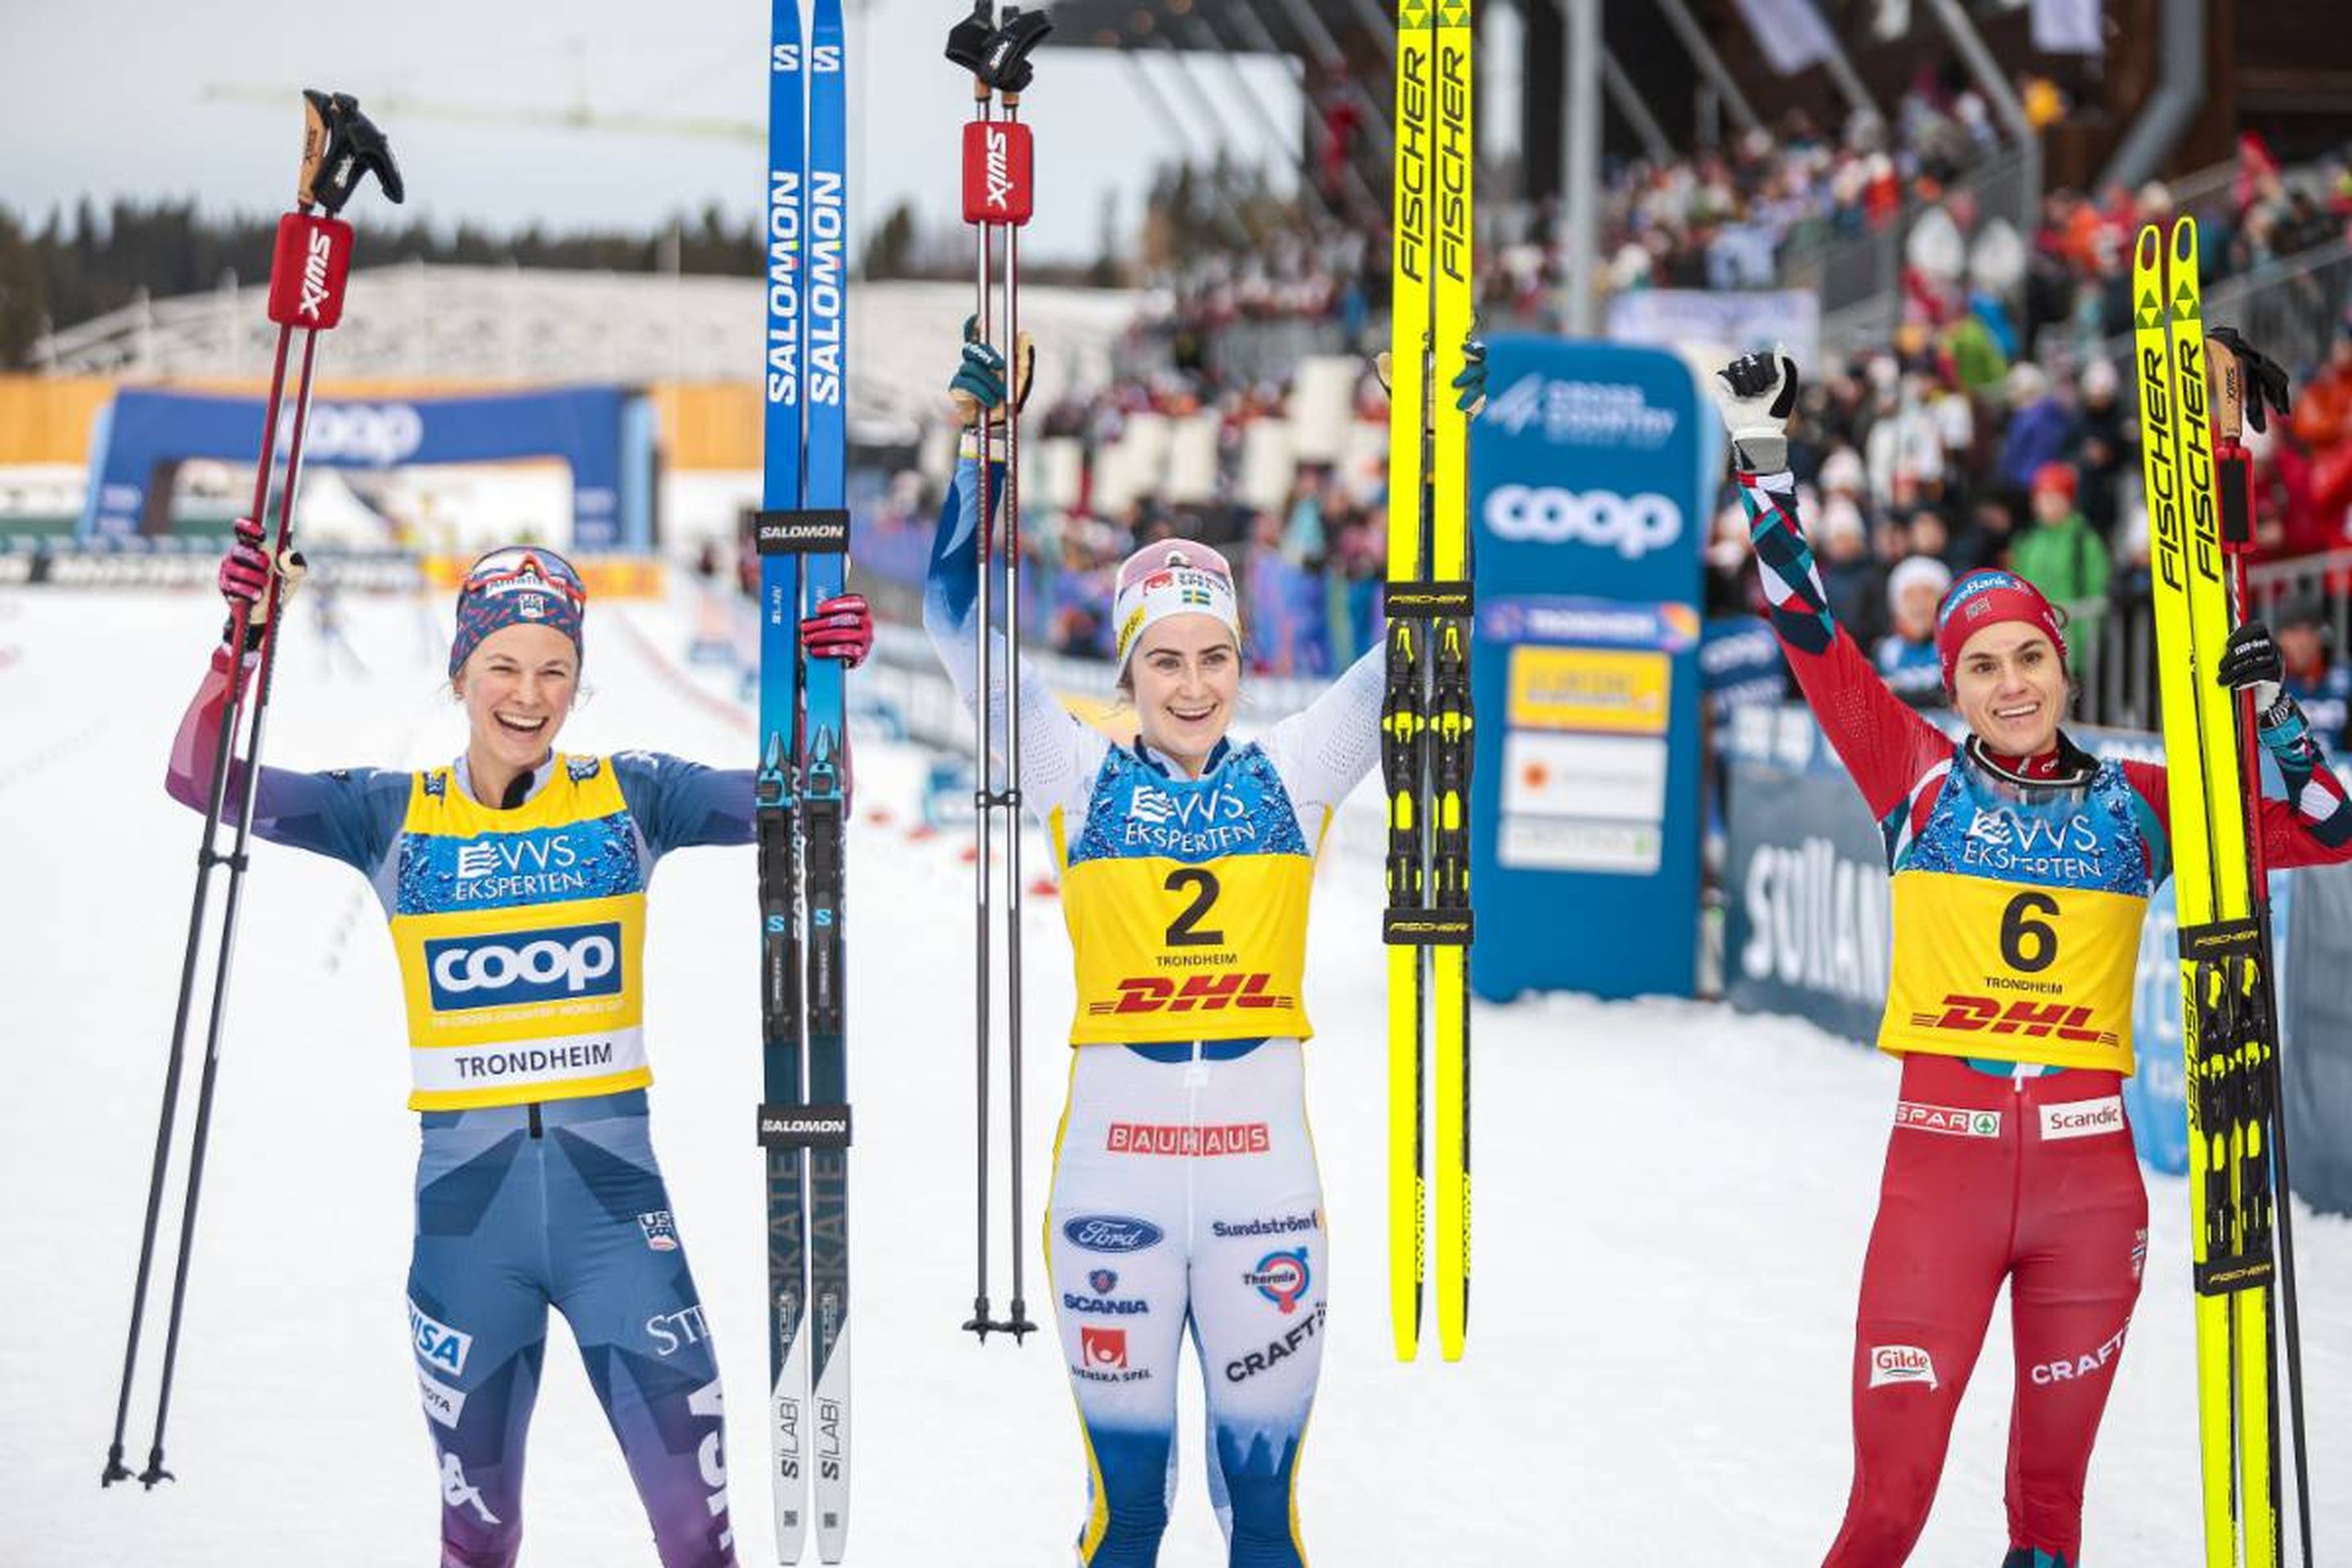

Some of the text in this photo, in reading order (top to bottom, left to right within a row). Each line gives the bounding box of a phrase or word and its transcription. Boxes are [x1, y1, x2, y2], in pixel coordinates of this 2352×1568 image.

[1401, 46, 1426, 283] FISCHER
[1441, 46, 1466, 283] FISCHER
[768, 171, 800, 406] SALOMON
[810, 172, 841, 407] SALOMON
[2144, 347, 2182, 592] FISCHER
[2180, 338, 2220, 583] FISCHER
[760, 525, 844, 540] SALOMON
[1485, 485, 1683, 559] coop
[1174, 783, 1245, 824] VVS
[1125, 821, 1255, 853] EKSPERTEN
[2011, 814, 2098, 852] VVS
[499, 835, 576, 871] VVS
[1964, 840, 2102, 878] EKSPERTEN
[455, 871, 586, 901] EKSPERTEN
[1165, 867, 1224, 947] 2
[2000, 891, 2060, 973] 6
[2195, 929, 2259, 947] FISCHER
[434, 936, 615, 992] coop
[1156, 953, 1239, 968] TRONDHEIM
[1114, 973, 1277, 1013] DHL
[1984, 977, 2064, 995] TRONDHEIM
[1936, 994, 2102, 1042] DHL
[455, 1043, 613, 1079] TRONDHEIM
[761, 1119, 846, 1134] SALOMON
[1895, 1106, 1968, 1130] SPAR
[2051, 1105, 2119, 1130] Scandic
[1111, 1126, 1268, 1155] BAUHAUS
[1079, 1220, 1140, 1249] Ford
[1242, 1271, 1297, 1286] Thermia
[2209, 1263, 2272, 1285] FISCHER
[1063, 1293, 1149, 1315] SCANIA
[1226, 1310, 1317, 1383] CRAFT
[1878, 1349, 1930, 1370] Gilde
[2032, 1328, 2123, 1385] CRAFT
